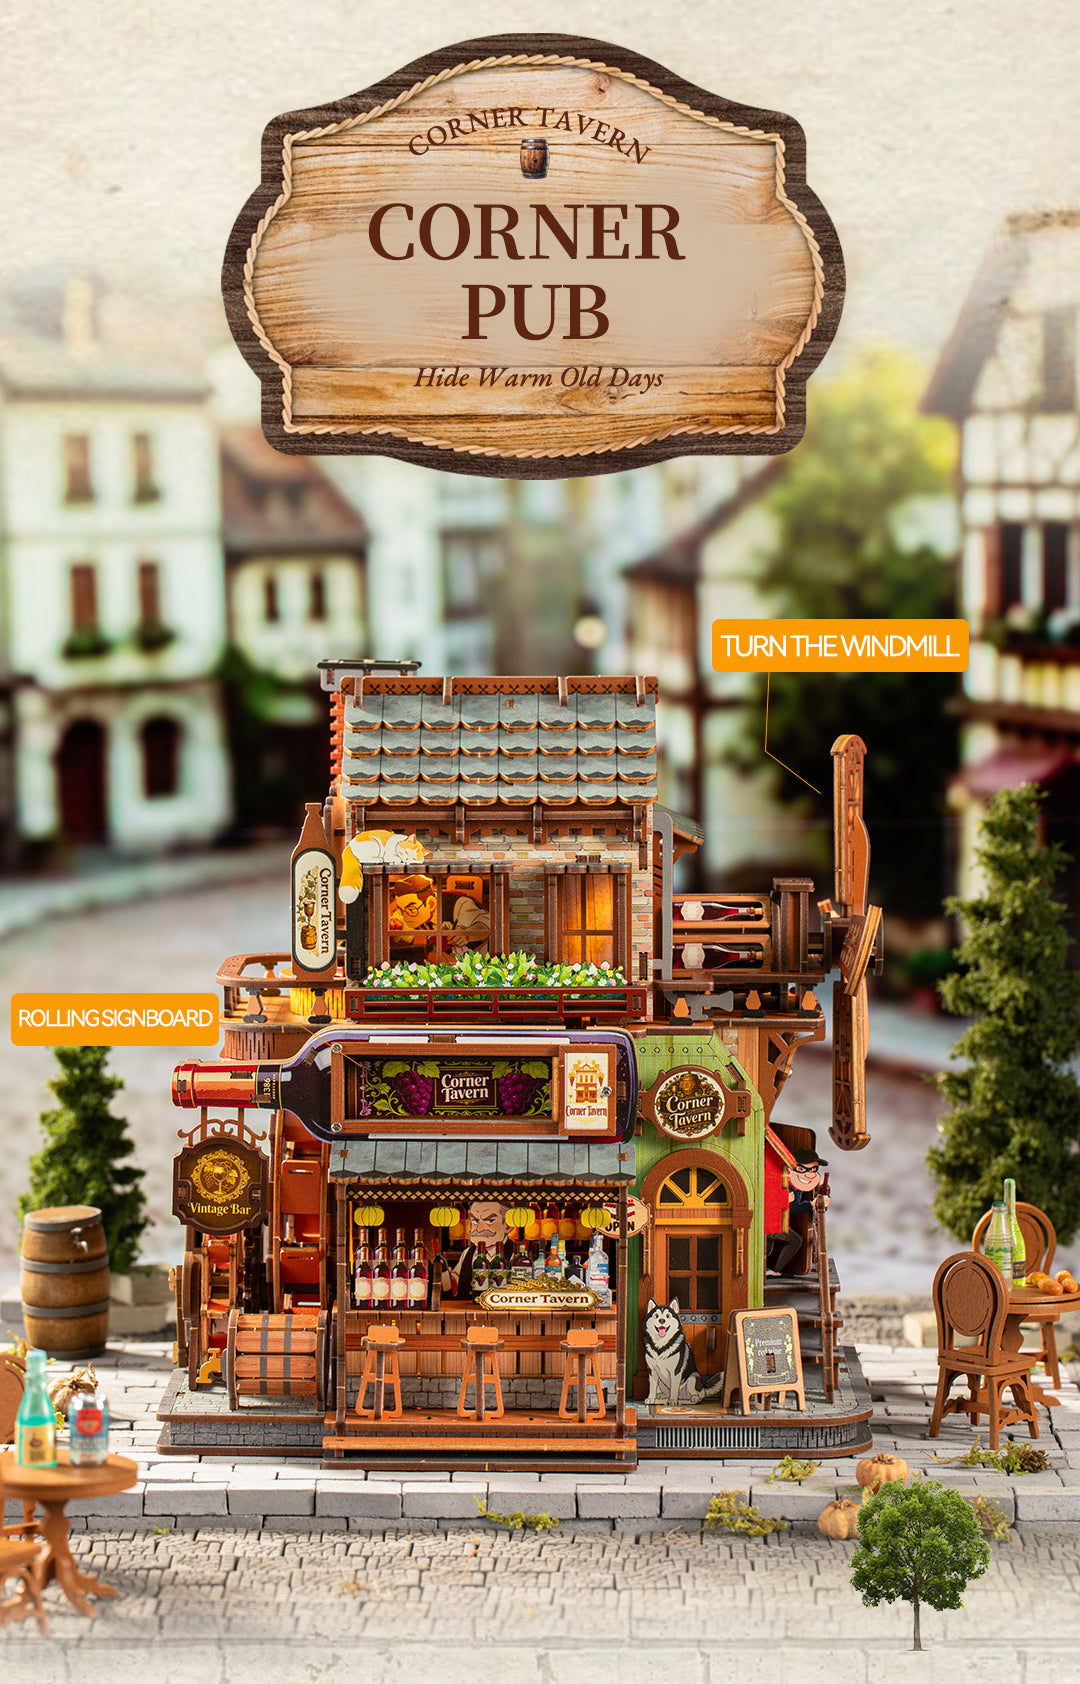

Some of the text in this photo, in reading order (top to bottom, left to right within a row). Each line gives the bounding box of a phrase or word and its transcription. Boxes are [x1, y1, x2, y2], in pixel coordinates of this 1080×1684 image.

[319, 867, 332, 954] Corner Tavern
[441, 1073, 490, 1089] Corner
[441, 1085, 489, 1103] Tavern
[565, 1105, 608, 1117] Corner Tavern
[666, 1095, 714, 1113] Corner
[668, 1111, 712, 1130] Tavern
[187, 1202, 252, 1217] Vintage Bar
[604, 1220, 636, 1232] OPN
[489, 1294, 589, 1304] Corner Tavern
